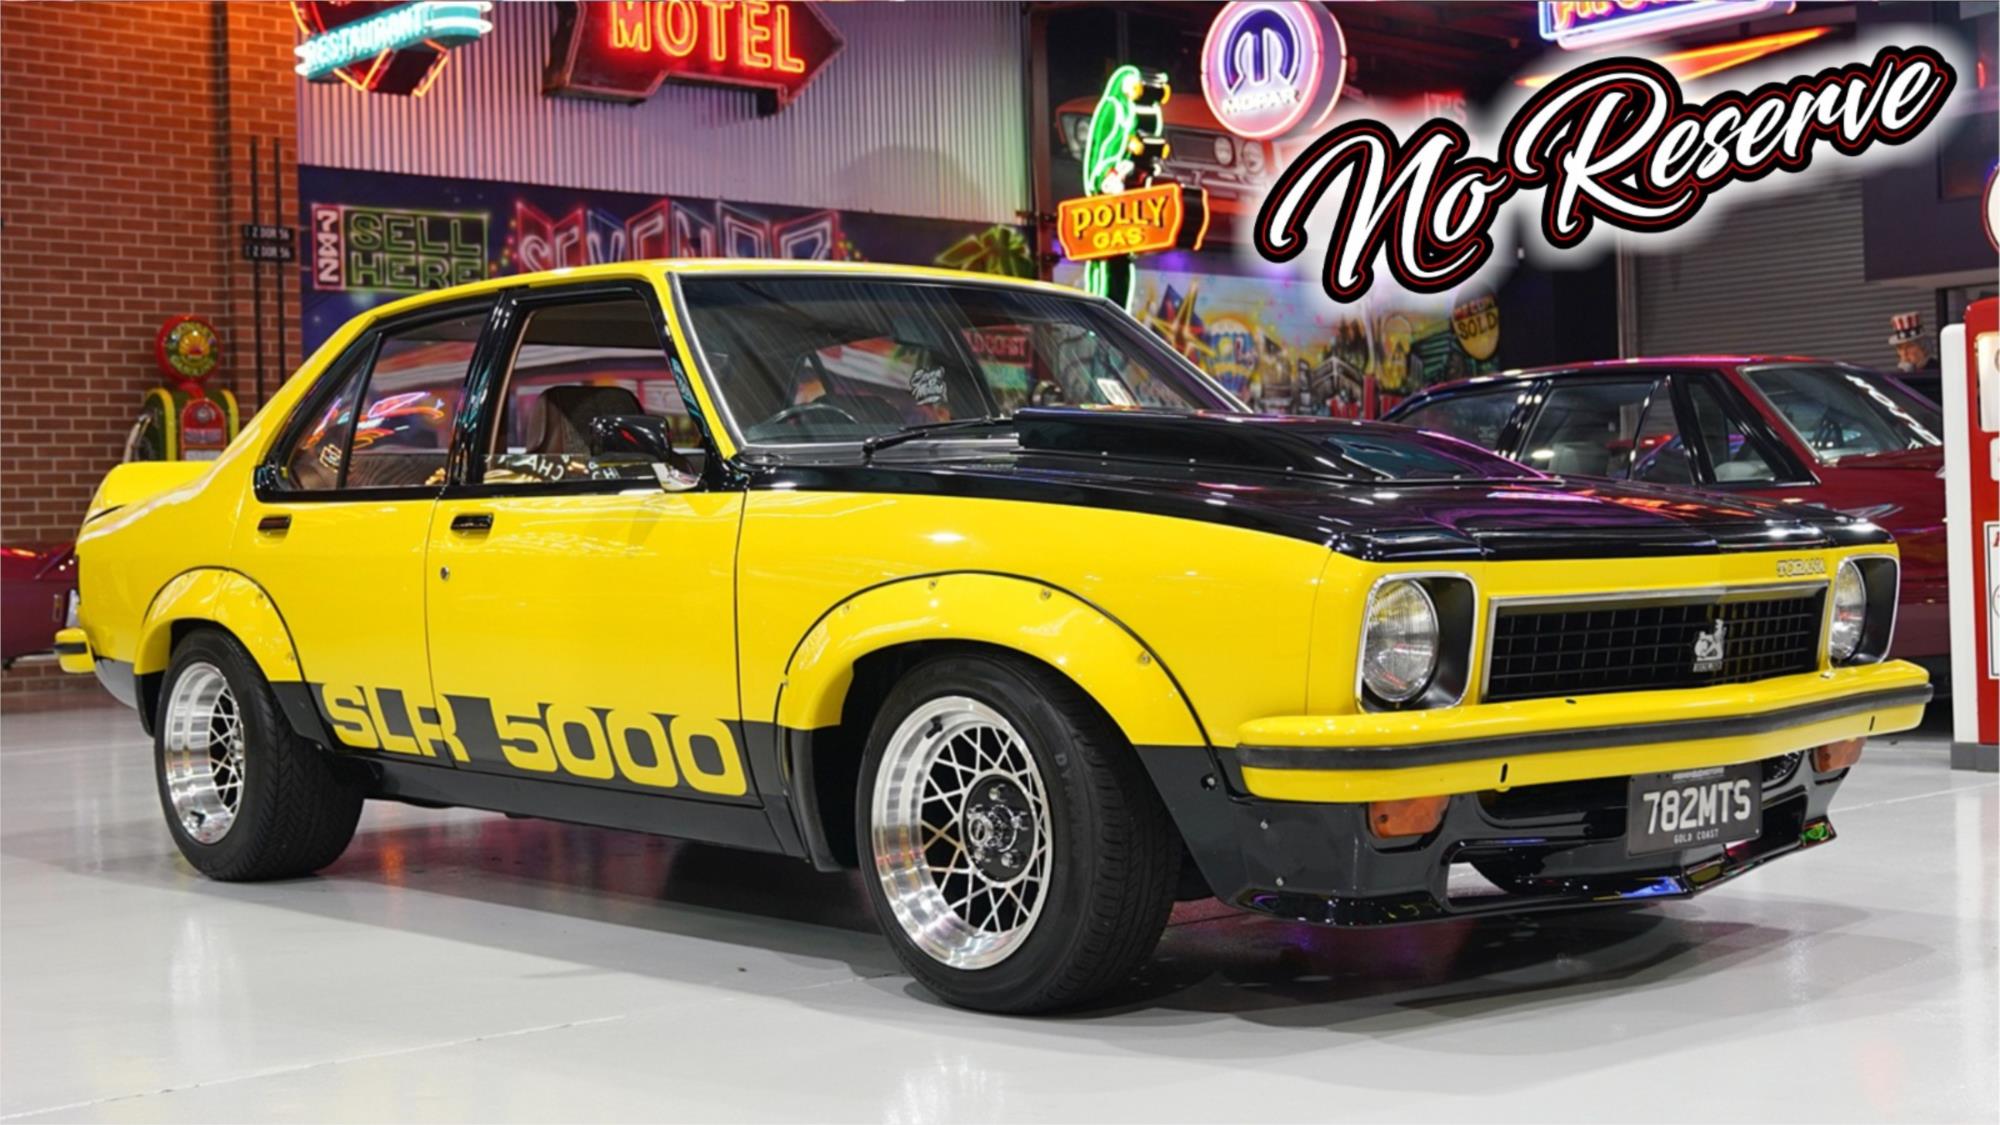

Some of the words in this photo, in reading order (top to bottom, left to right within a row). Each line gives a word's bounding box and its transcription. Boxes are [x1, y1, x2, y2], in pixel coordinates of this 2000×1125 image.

[304, 3, 432, 72] RESTAURANT
[609, 1, 805, 73] MOTEL
[1222, 90, 1300, 114] MOPAR
[351, 212, 481, 256] SELL
[1072, 196, 1168, 238] POLLY
[1093, 227, 1143, 249] GAS
[351, 251, 482, 289] HERE
[1458, 311, 1498, 340] SOLD
[322, 684, 471, 763] SLR
[489, 696, 748, 796] 5000
[1643, 779, 1751, 834] 782MTS
[1674, 832, 1693, 844] GOLD
[1696, 829, 1719, 841] COAST
